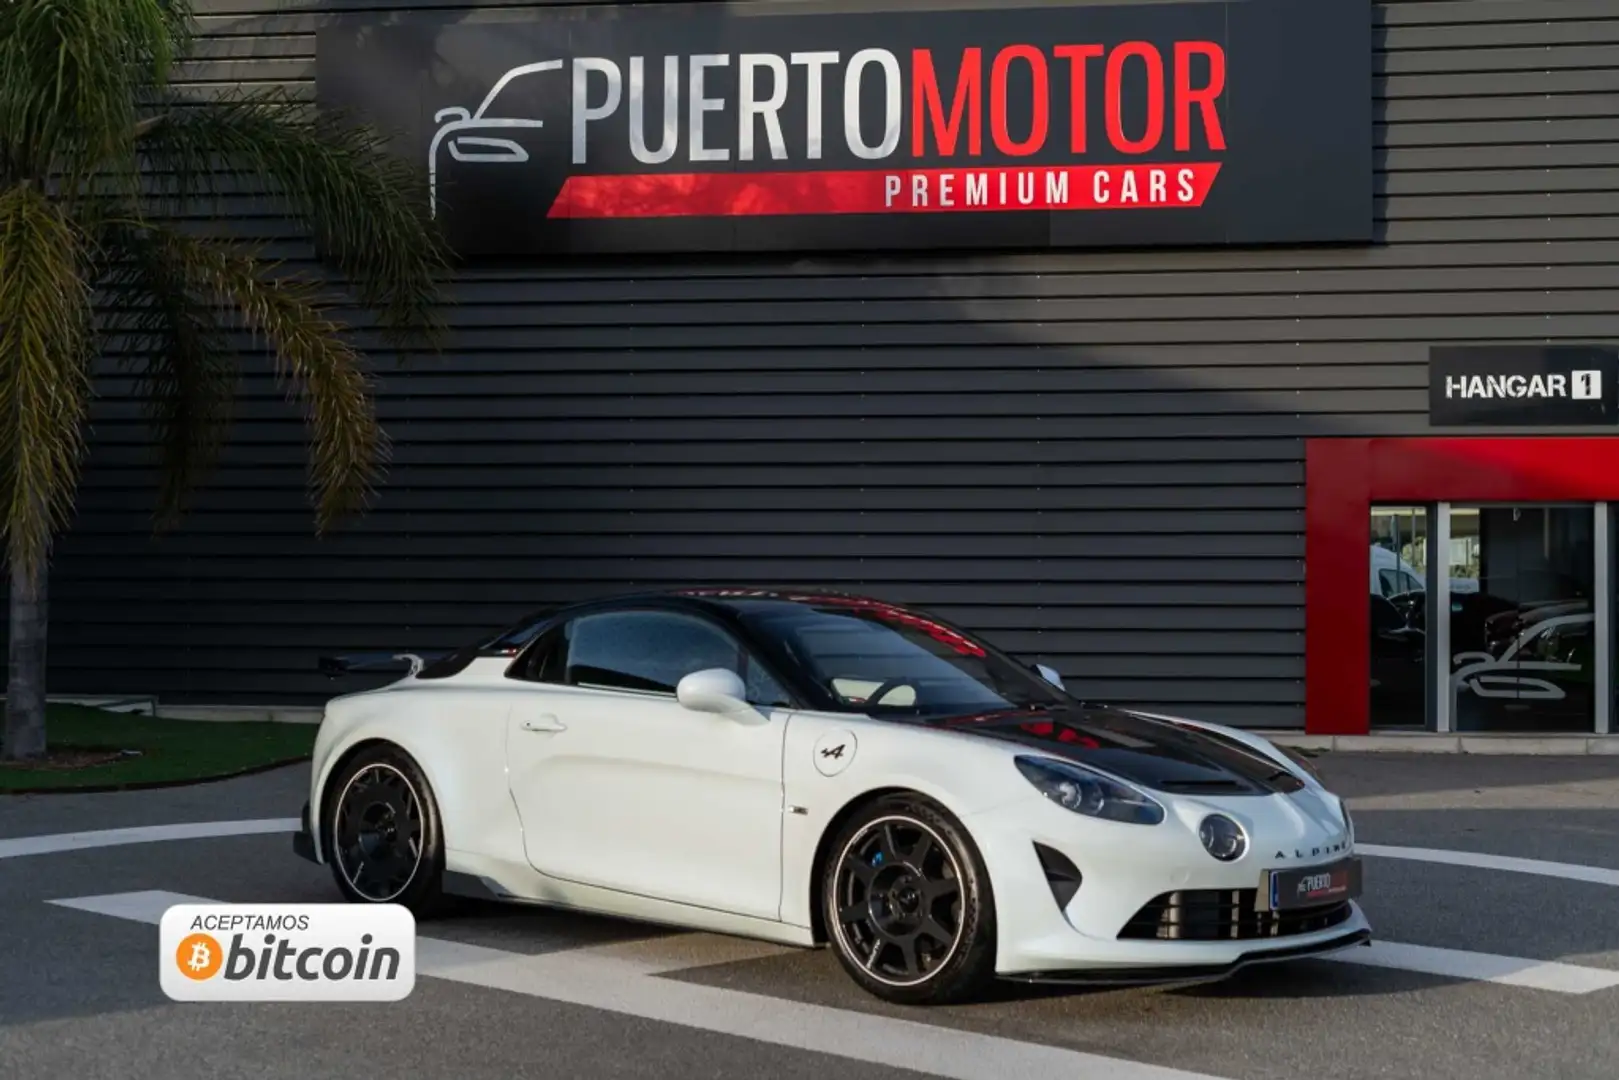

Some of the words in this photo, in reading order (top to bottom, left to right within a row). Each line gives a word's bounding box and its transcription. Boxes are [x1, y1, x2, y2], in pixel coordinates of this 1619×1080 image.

[571, 40, 1227, 164] PUERTOMOTOR
[884, 170, 1070, 208] PREMIUM
[1094, 168, 1197, 206] CARS
[1445, 374, 1567, 398] HANGAR
